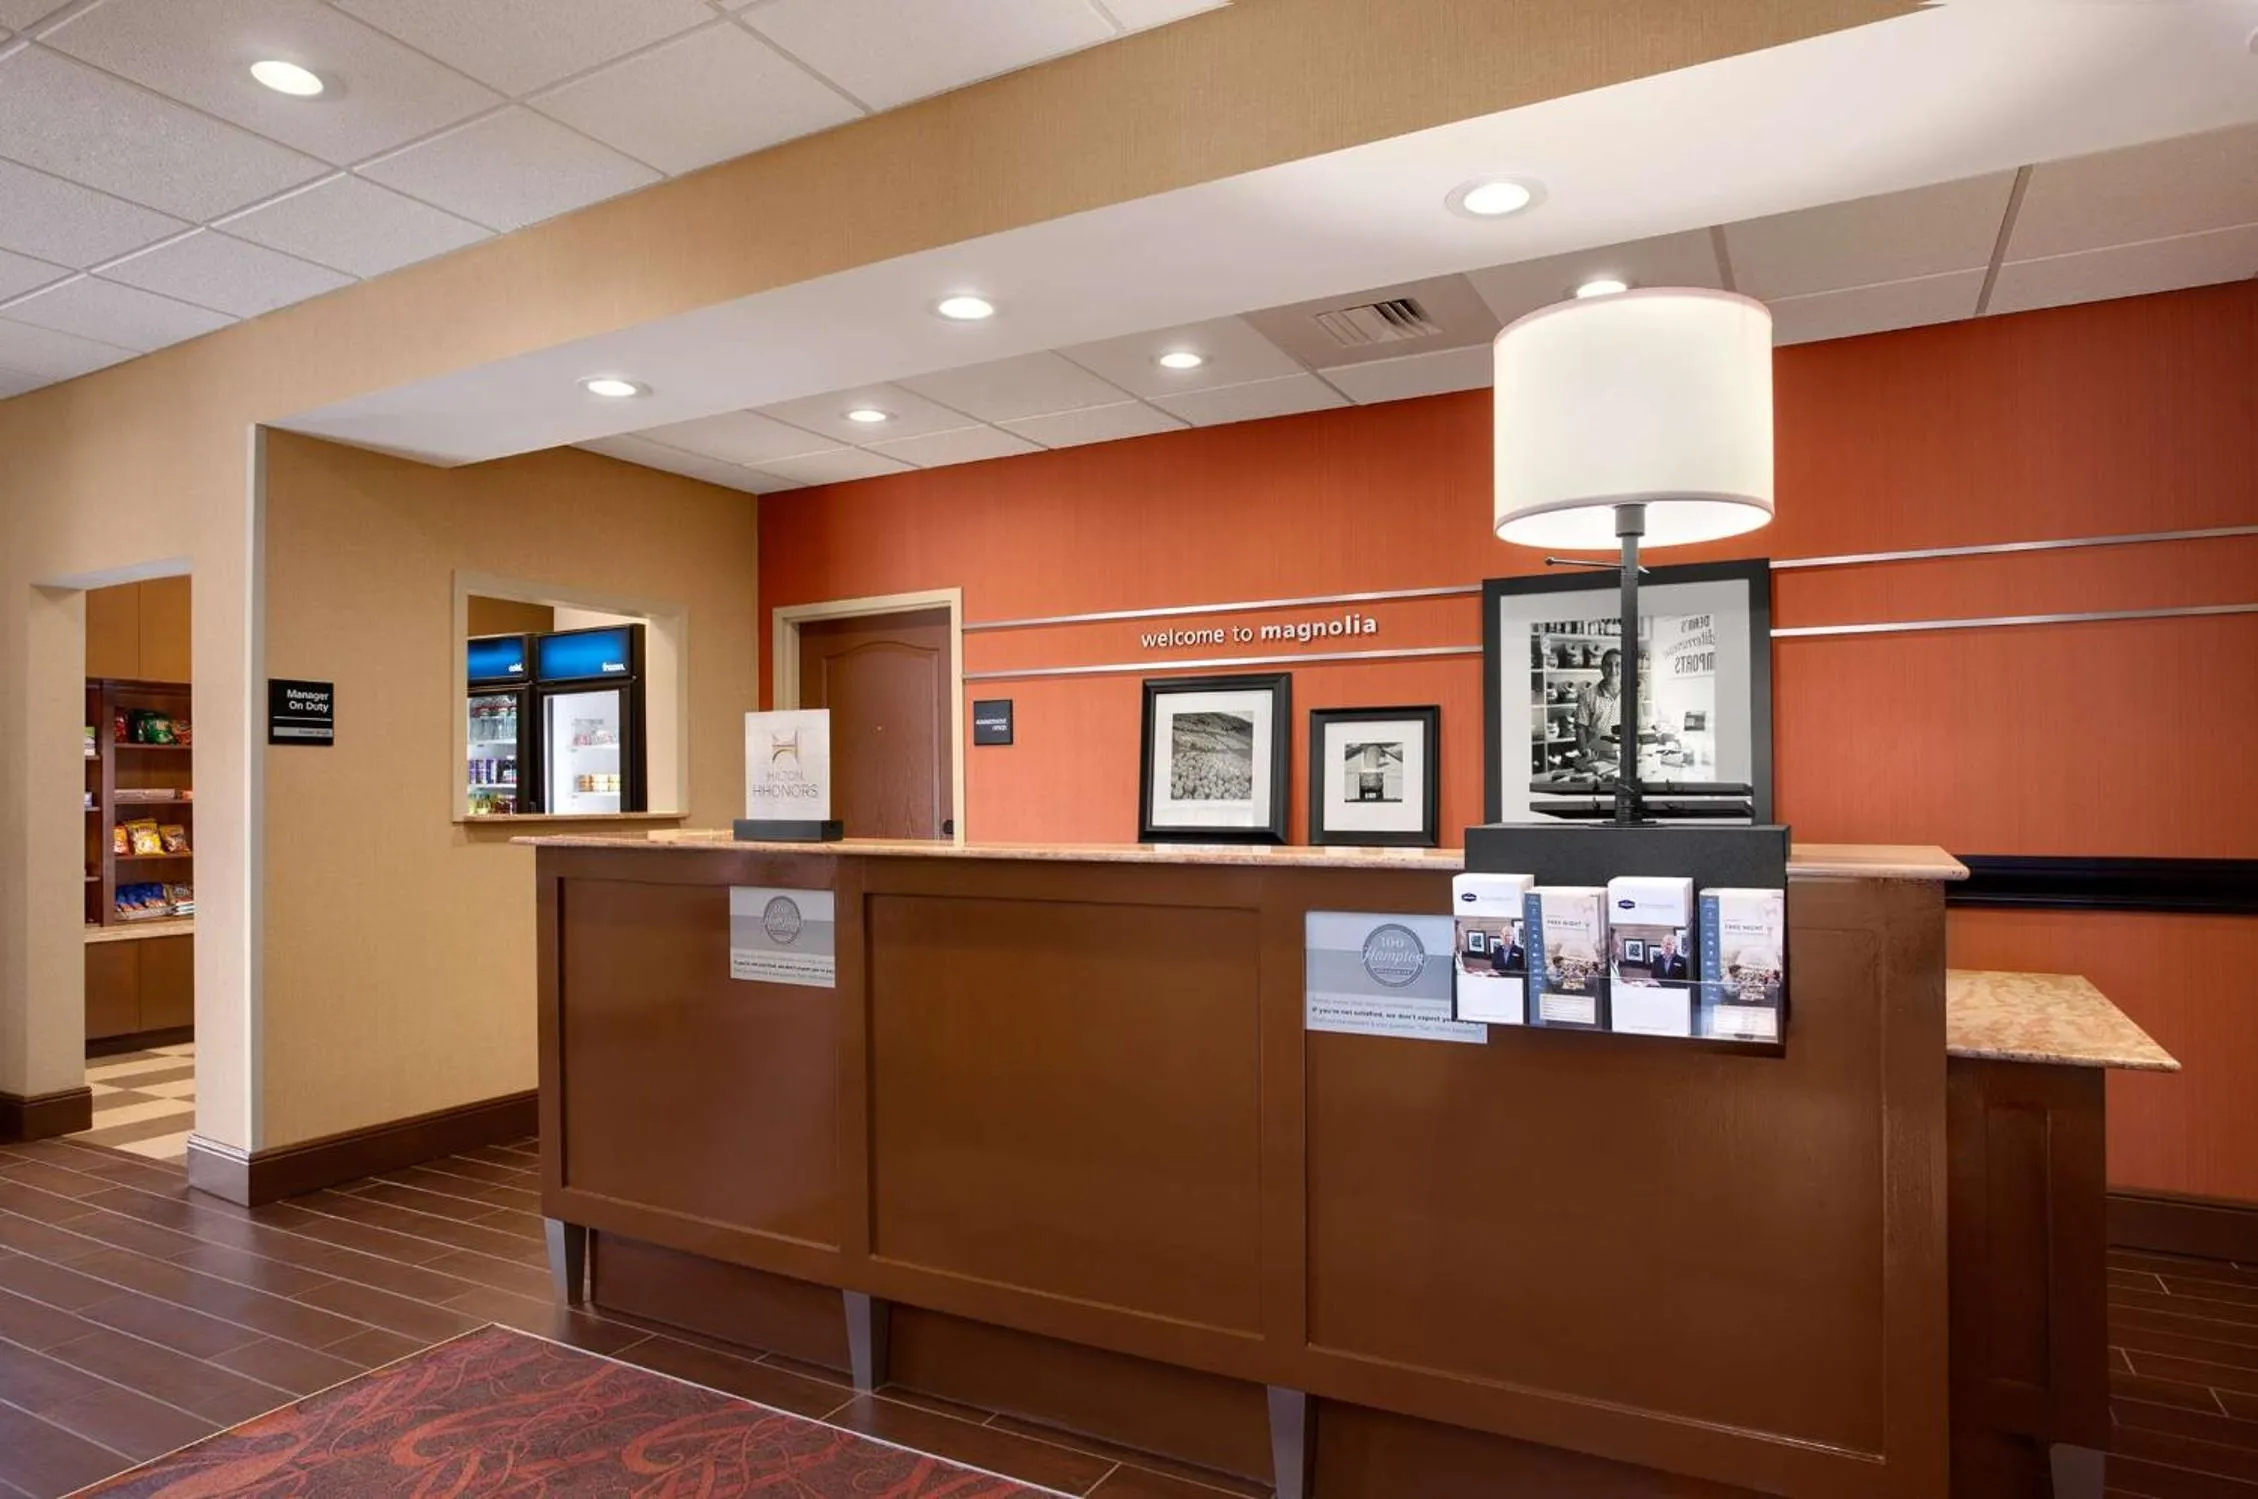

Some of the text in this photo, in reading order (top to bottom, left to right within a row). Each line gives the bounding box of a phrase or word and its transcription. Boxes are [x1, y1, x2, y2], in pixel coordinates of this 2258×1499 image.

[1141, 613, 1378, 648] welcome to magnolia
[287, 689, 329, 701] Manager
[289, 701, 329, 713] On Duty
[767, 770, 805, 782] HILTON
[1363, 945, 1424, 967] Hampton
